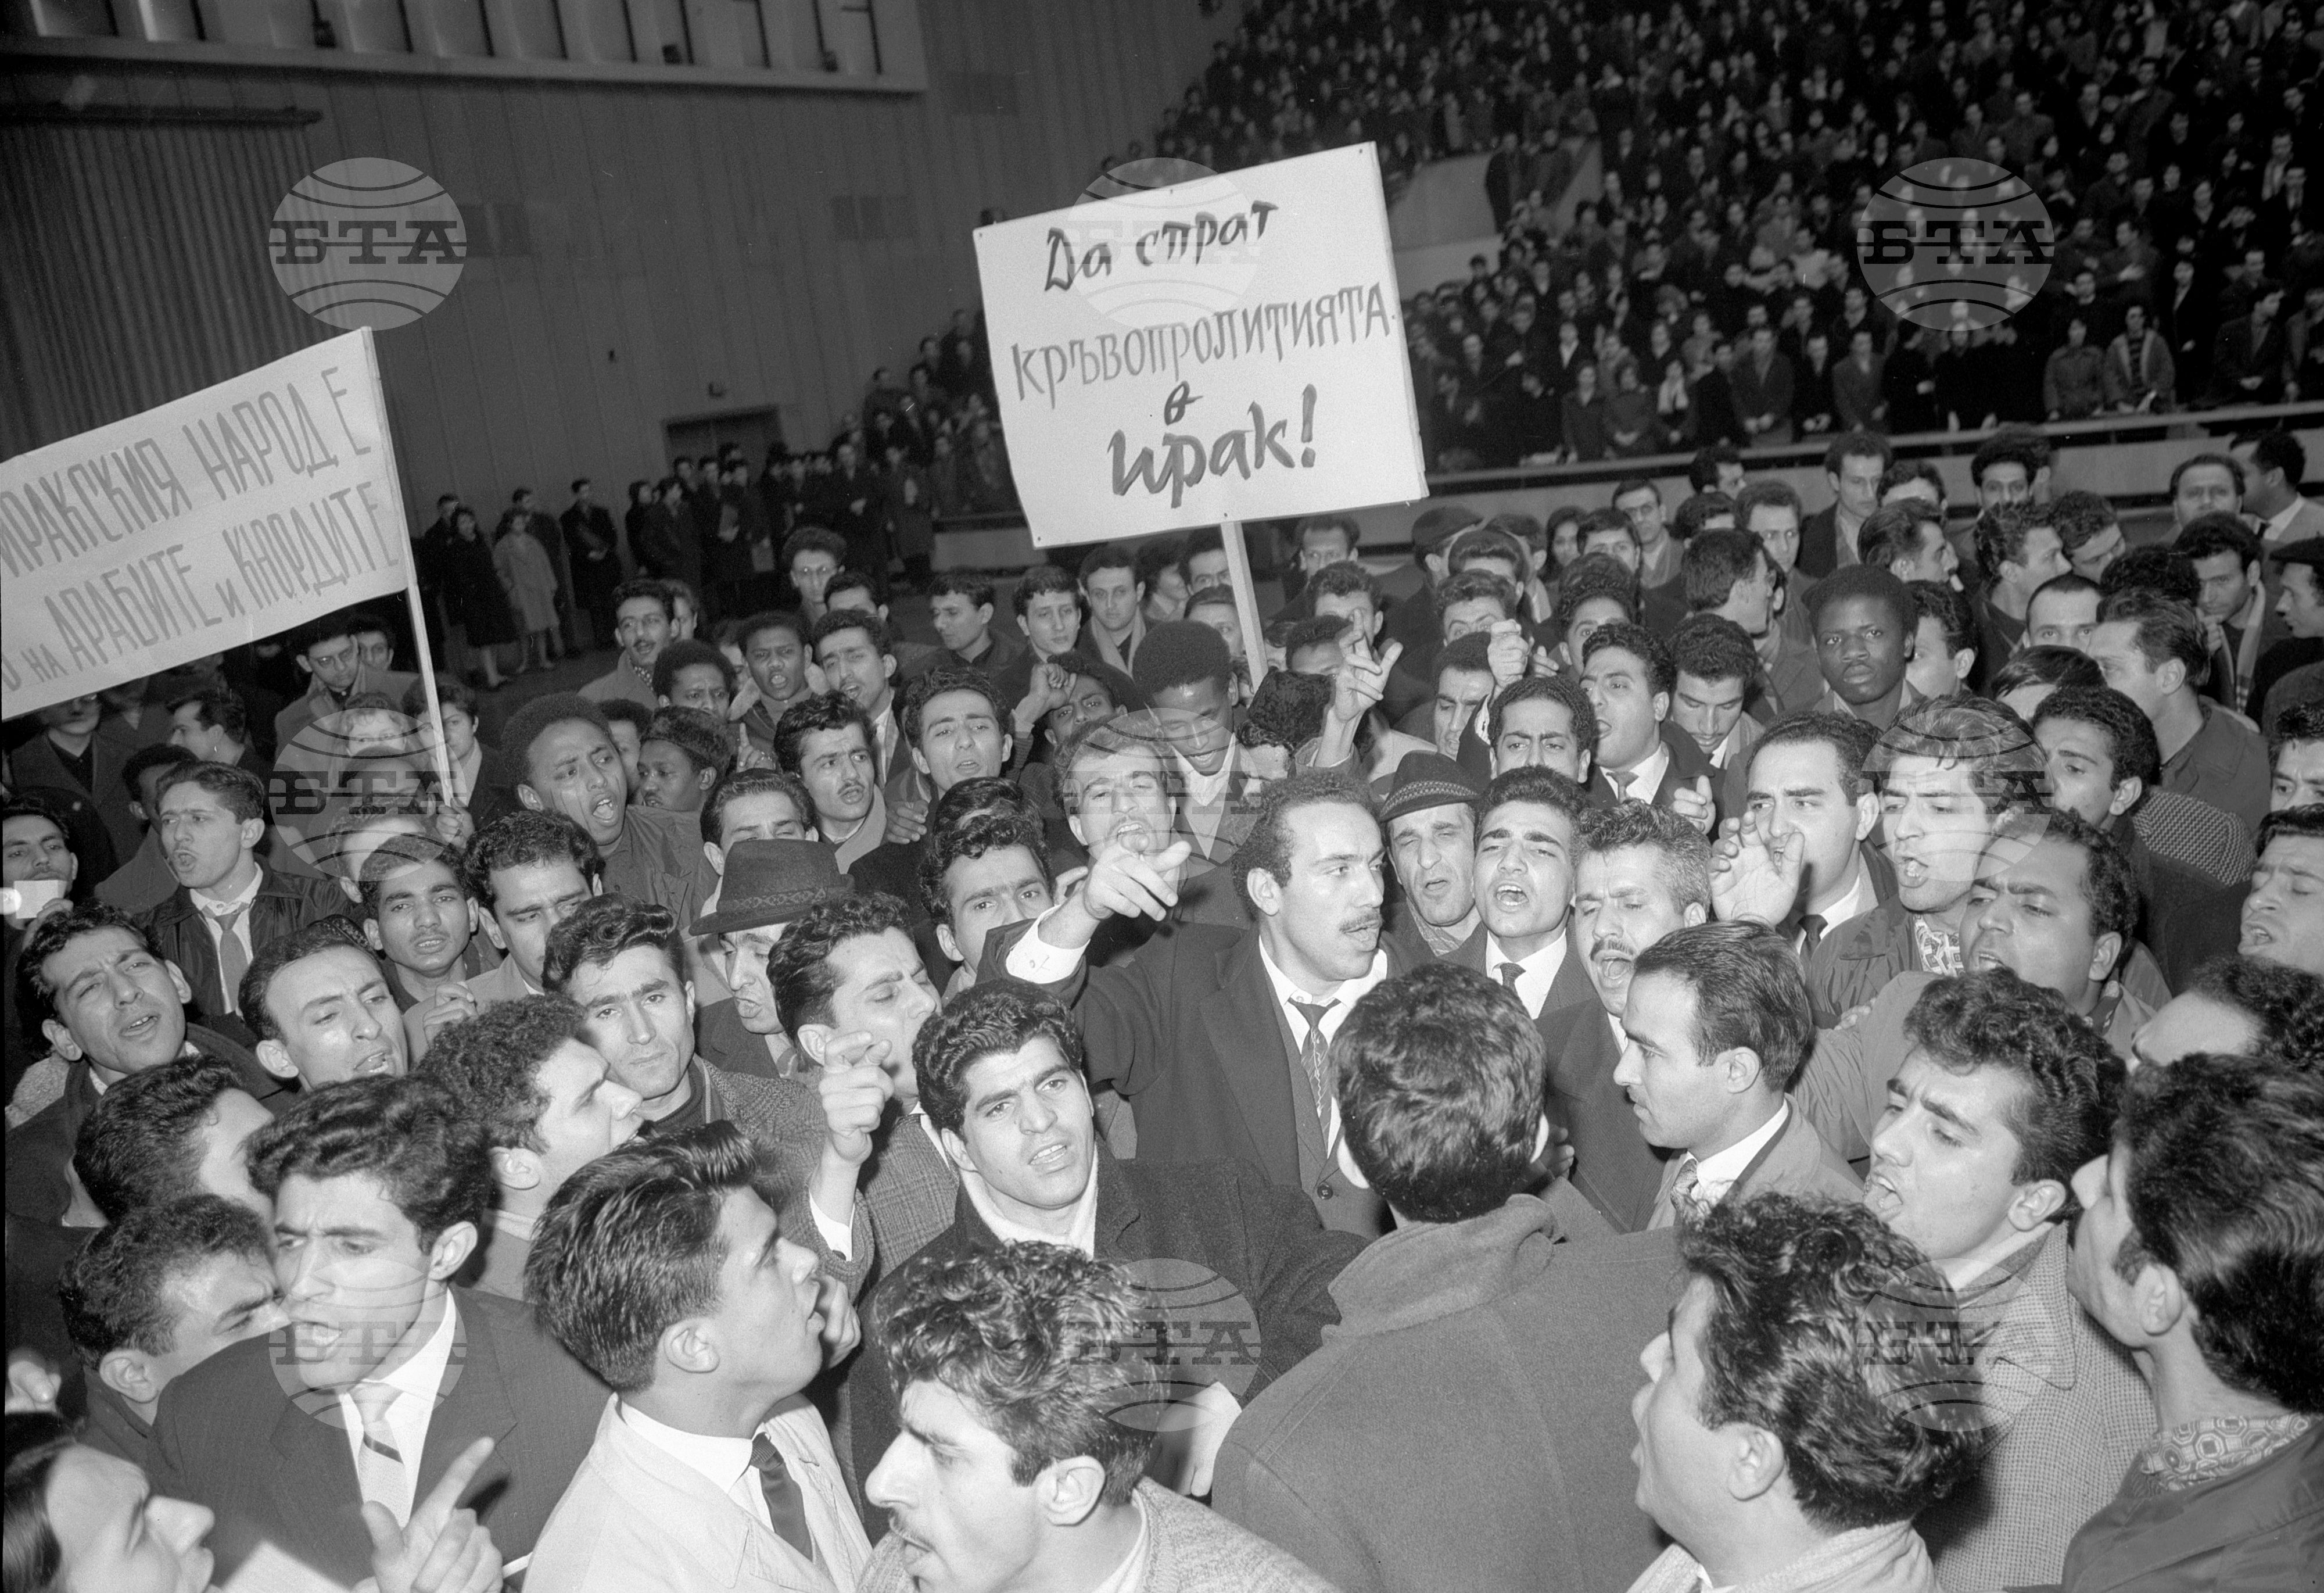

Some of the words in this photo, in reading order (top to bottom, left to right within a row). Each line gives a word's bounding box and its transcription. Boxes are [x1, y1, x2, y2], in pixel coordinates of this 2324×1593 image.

[1045, 227, 1112, 291] Да
[1135, 200, 1279, 266] спрат
[1012, 281, 1391, 409] КРЪВОПРОЛИТИЯТА
[182, 382, 339, 500] НАРОД
[321, 367, 371, 456] Е
[1164, 381, 1203, 425] в
[44, 544, 222, 671] АРАБИТЕ
[20, 643, 69, 682] НА
